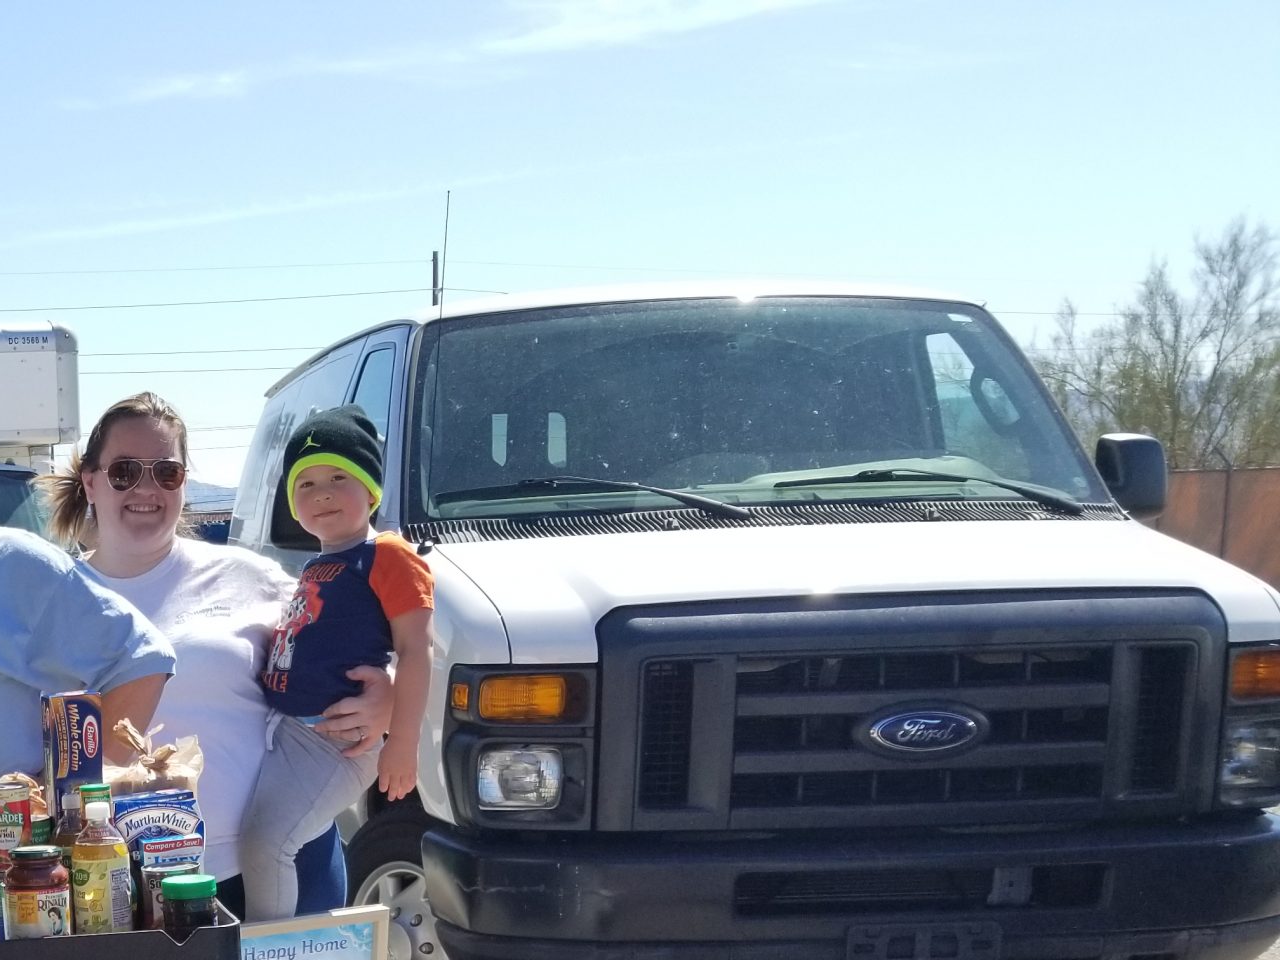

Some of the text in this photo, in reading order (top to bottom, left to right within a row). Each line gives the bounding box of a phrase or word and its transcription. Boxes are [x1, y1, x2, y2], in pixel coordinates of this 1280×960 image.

[8, 336, 19, 345] DC
[67, 703, 82, 772] Whole Grain
[86, 726, 95, 754] Barilla
[897, 718, 957, 742] Ford
[124, 811, 192, 838] Martha White
[145, 841, 175, 851] Compare
[184, 838, 200, 846] Save!
[302, 939, 348, 955] Home
